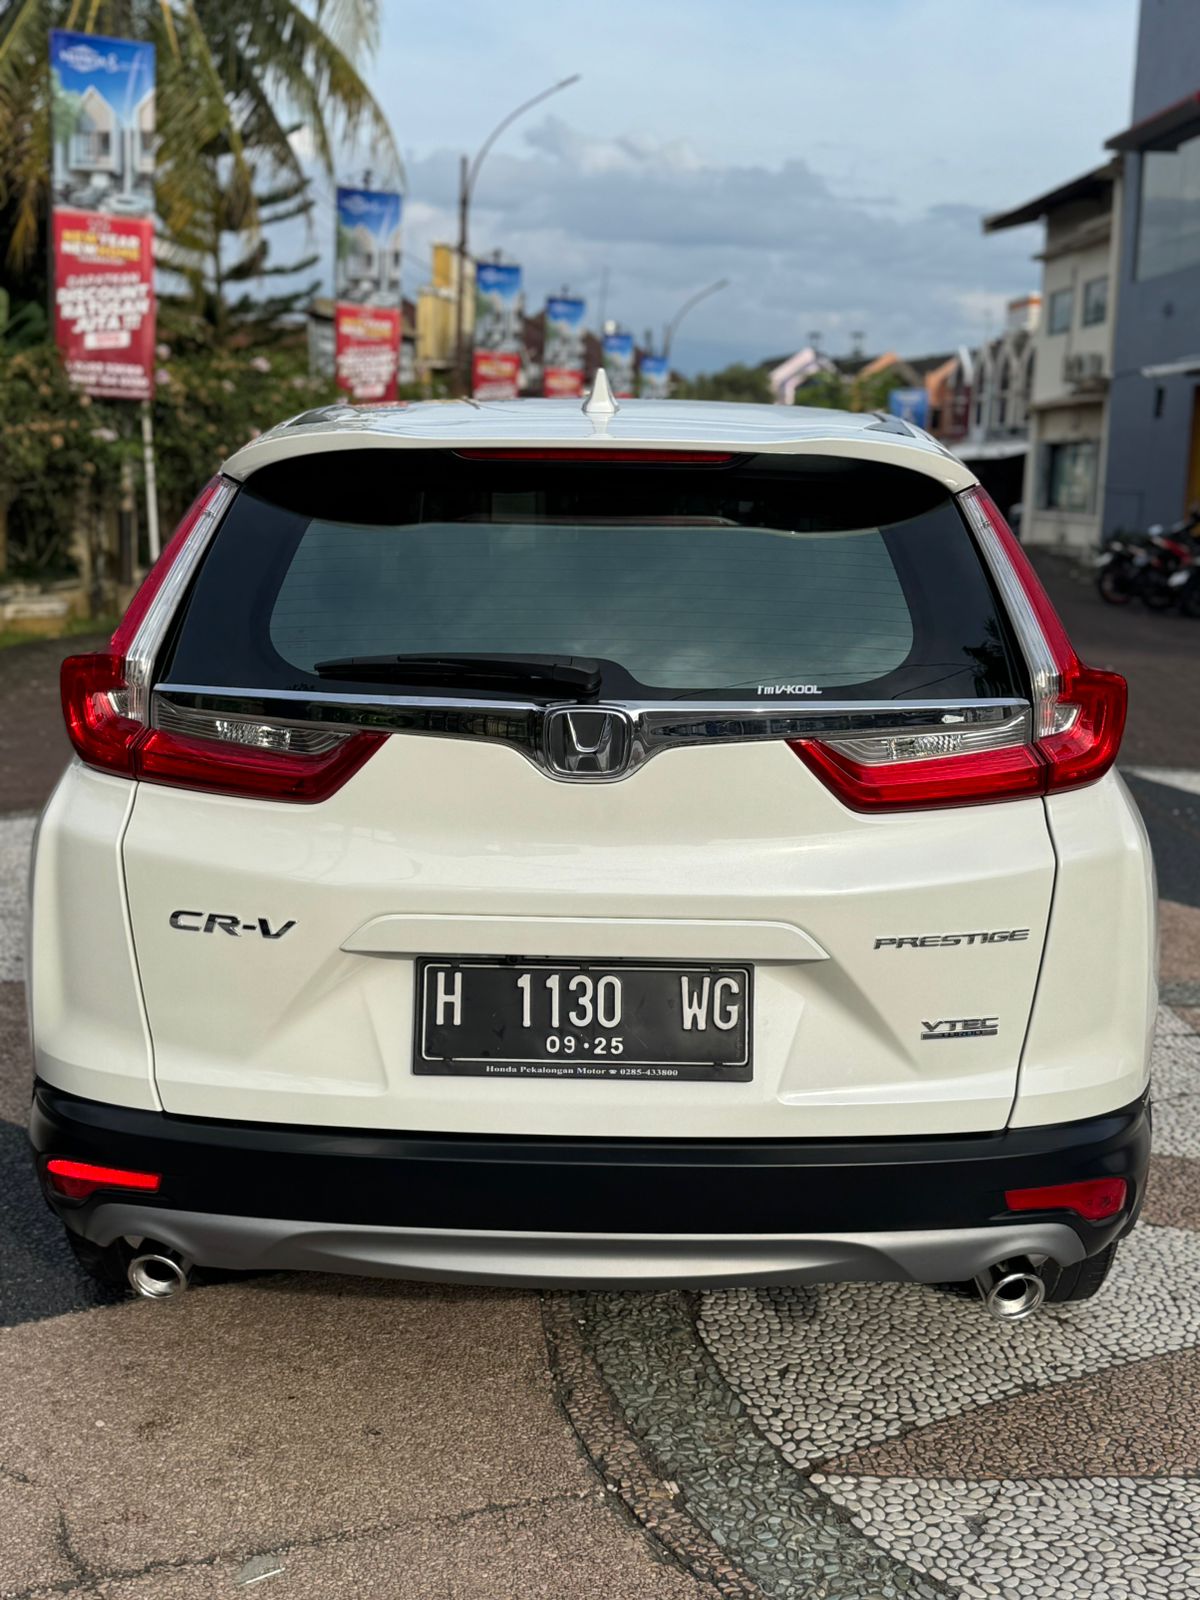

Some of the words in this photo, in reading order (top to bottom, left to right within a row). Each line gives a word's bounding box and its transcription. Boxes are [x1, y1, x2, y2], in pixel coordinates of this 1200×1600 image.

[775, 685, 822, 694] V-KOOL
[169, 910, 297, 939] CR-V
[873, 928, 1030, 950] PRESTIGE
[435, 971, 463, 1026] H
[517, 973, 622, 1028] 1130
[681, 976, 740, 1031] WG
[921, 1017, 999, 1032] VTEC
[486, 1065, 517, 1073] Honda
[520, 1066, 574, 1076] Pekalongan
[577, 1066, 606, 1075] Motor
